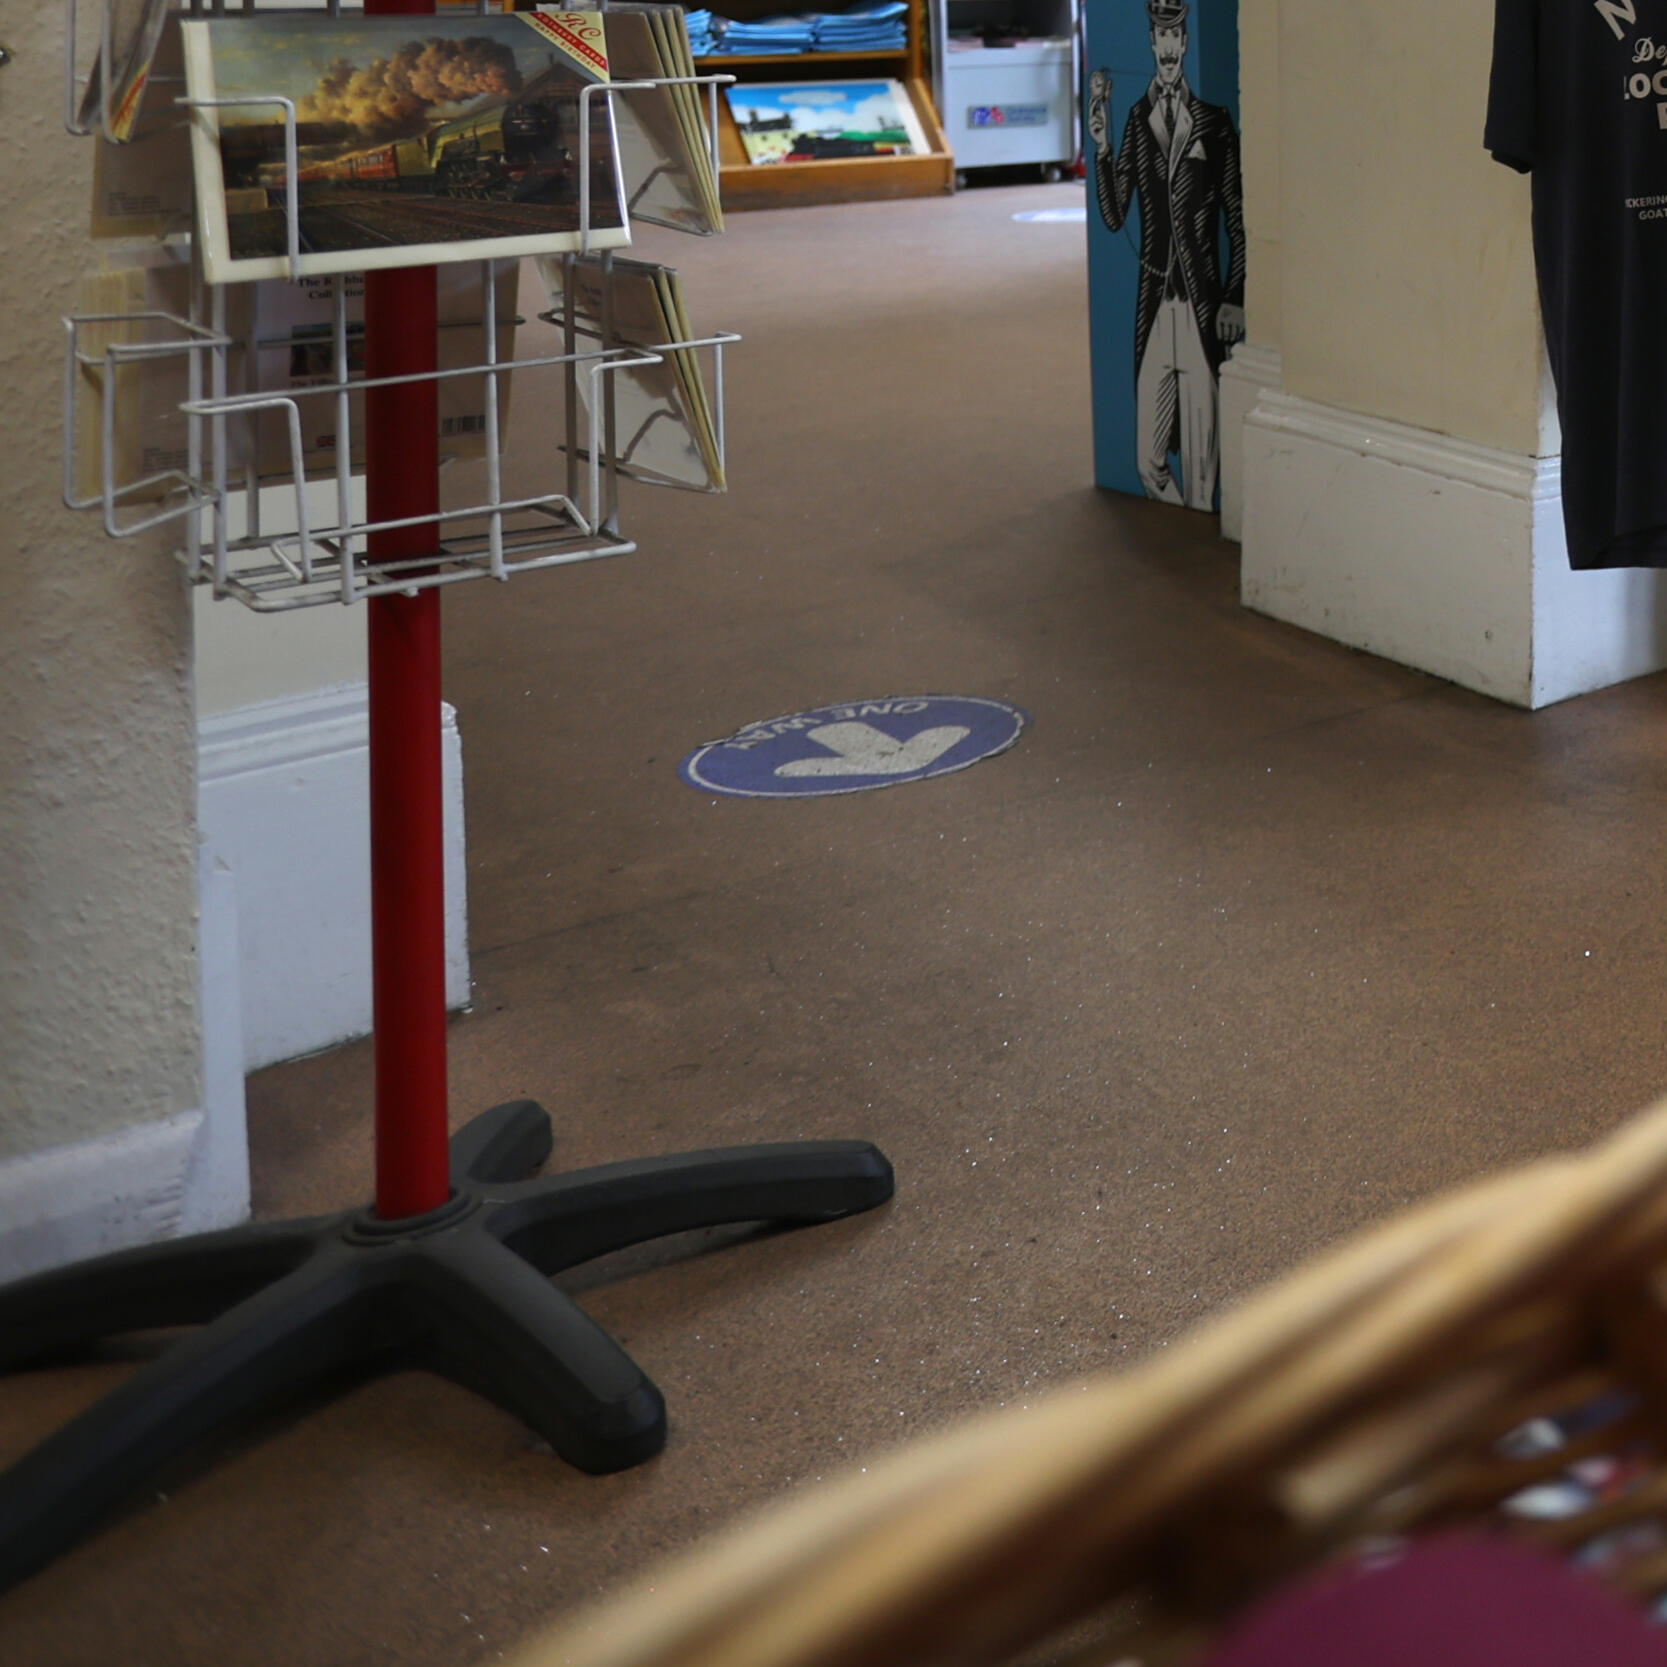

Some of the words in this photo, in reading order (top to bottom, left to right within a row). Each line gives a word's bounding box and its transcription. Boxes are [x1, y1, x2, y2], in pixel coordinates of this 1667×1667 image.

[537, 13, 578, 43] ROTHBURY
[579, 44, 605, 66] CARDS
[556, 12, 602, 40] RC
[534, 22, 559, 40] HAPPY
[560, 41, 596, 68] BIRTHDAY
[299, 277, 320, 288] The
[835, 701, 929, 722] ONE
[724, 717, 823, 750] WAY
